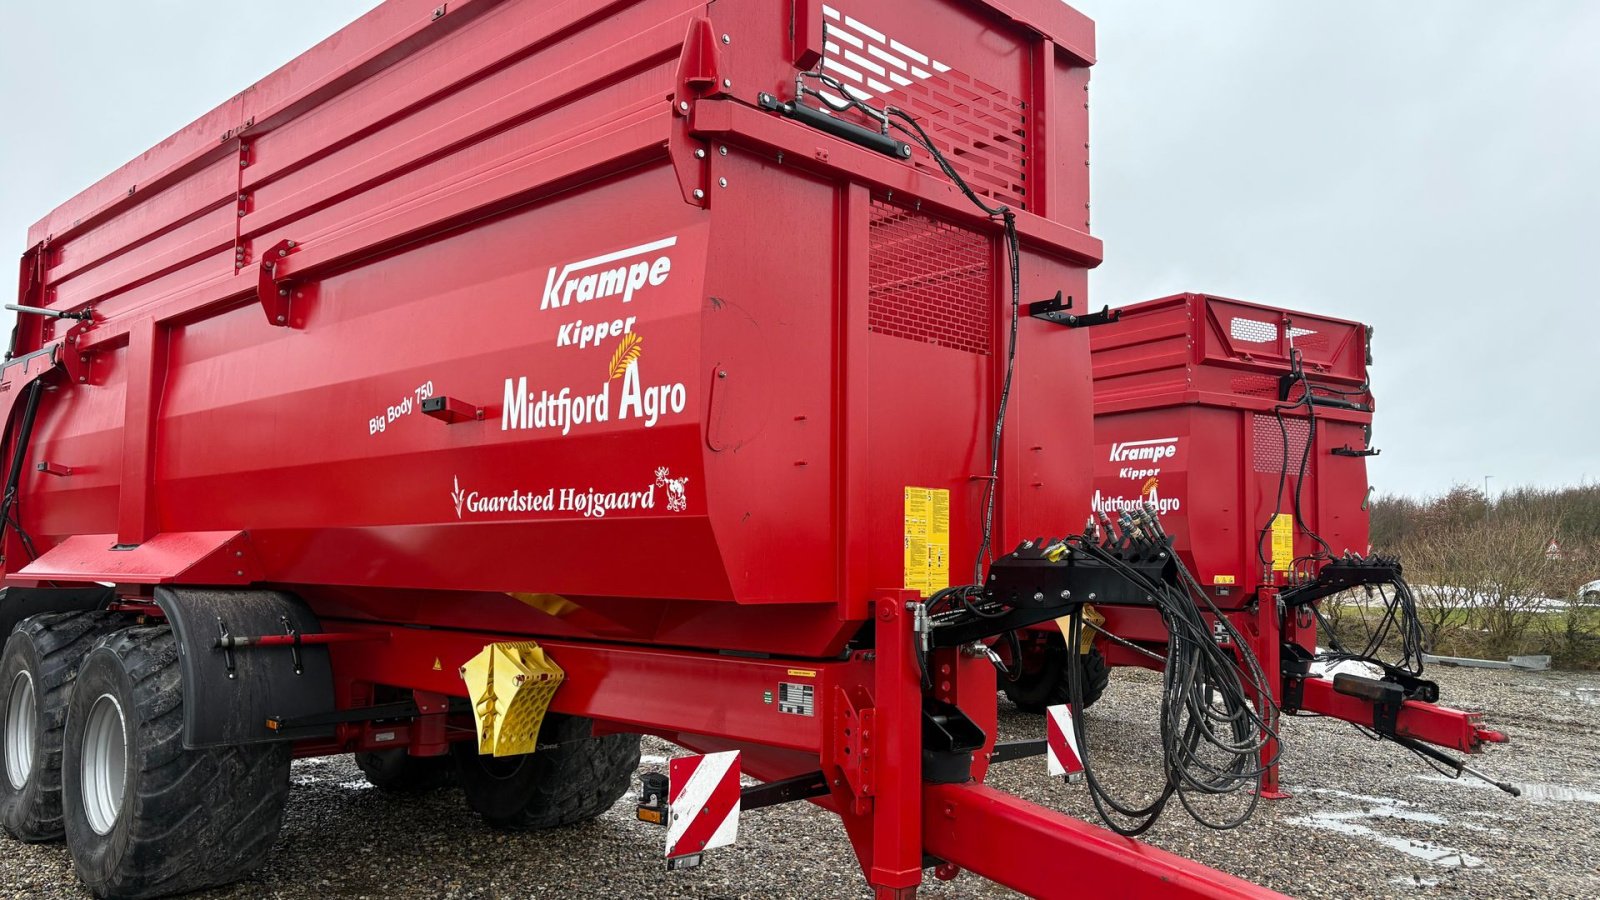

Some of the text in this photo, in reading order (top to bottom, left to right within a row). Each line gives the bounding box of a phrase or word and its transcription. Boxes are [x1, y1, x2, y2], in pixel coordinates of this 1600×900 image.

[540, 236, 677, 310] Krampe
[557, 316, 637, 349] Kipper
[369, 380, 433, 435] Big Body 750
[501, 357, 687, 436] Midtfjord Agro
[1109, 437, 1178, 463] Krampe
[1120, 467, 1160, 480] Kipper
[466, 484, 656, 518] Gaardsted Højgaard
[1148, 486, 1180, 515] Agro
